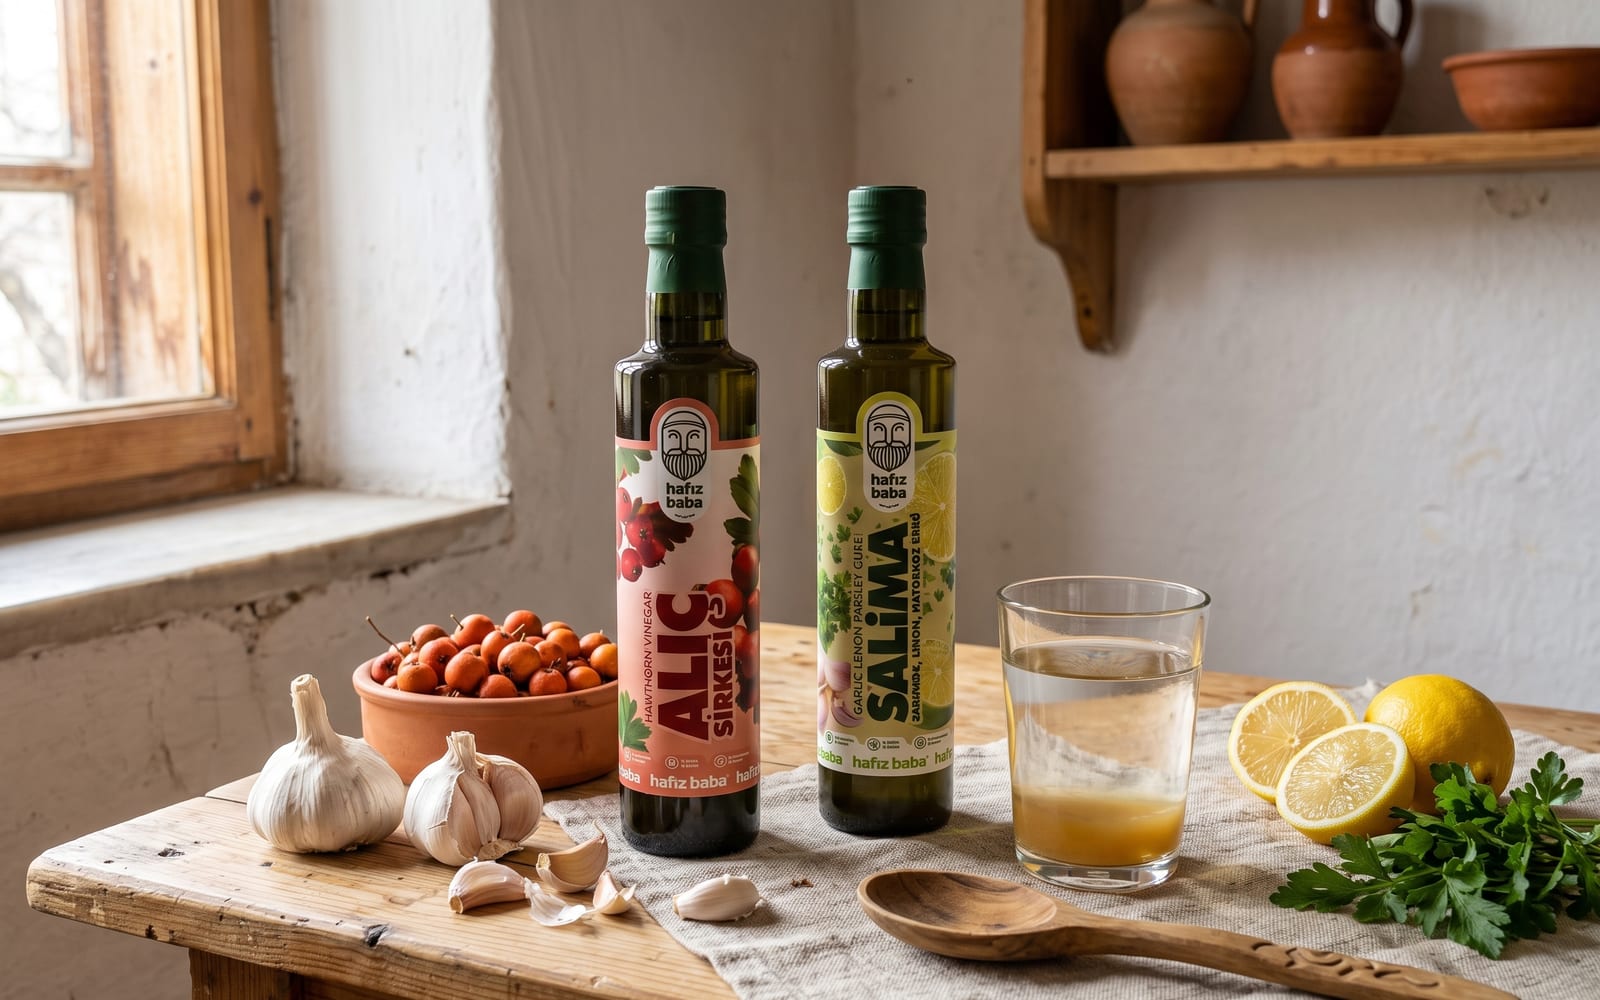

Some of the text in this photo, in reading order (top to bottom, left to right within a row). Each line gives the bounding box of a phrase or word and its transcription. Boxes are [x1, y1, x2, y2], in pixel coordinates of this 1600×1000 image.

[871, 487, 907, 499] baba
[666, 496, 703, 509] baba
[853, 573, 863, 623] PARSLEY
[643, 591, 653, 723] HAWTHORN VINEGAR
[853, 673, 863, 715] GARLIC
[892, 756, 927, 770] baba
[690, 775, 727, 790] baba
